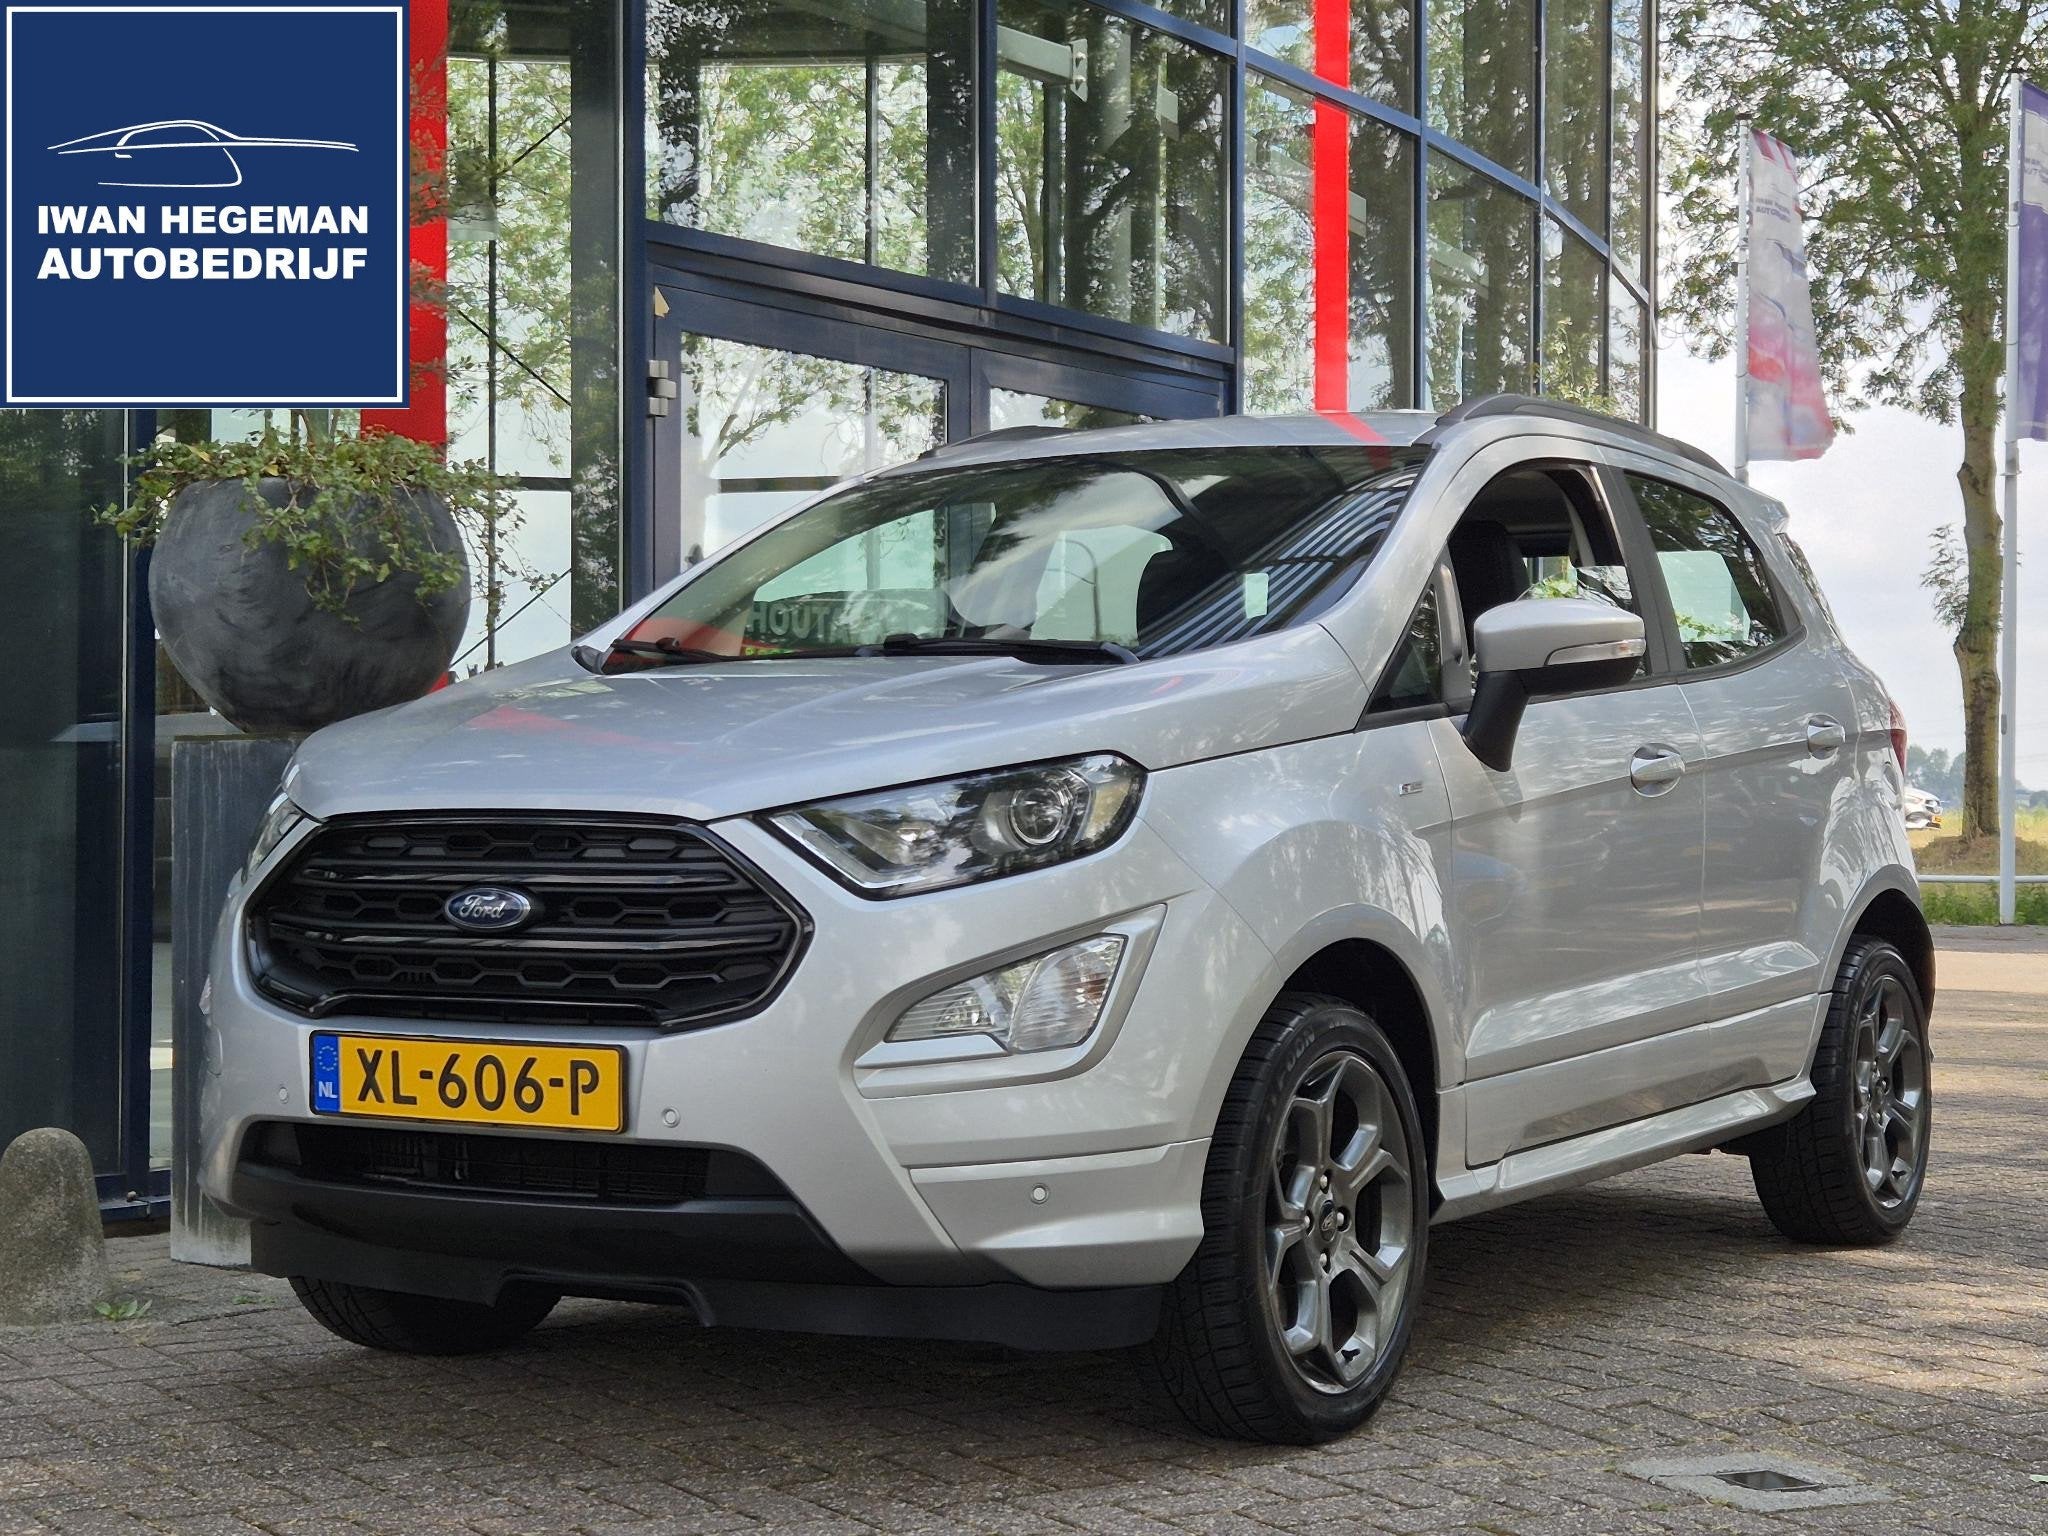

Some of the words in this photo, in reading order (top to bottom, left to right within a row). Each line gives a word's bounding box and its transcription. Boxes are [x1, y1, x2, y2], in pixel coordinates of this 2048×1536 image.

[459, 894, 507, 919] Ford
[318, 1080, 338, 1099] NL
[356, 1047, 600, 1116] XL-606-P
